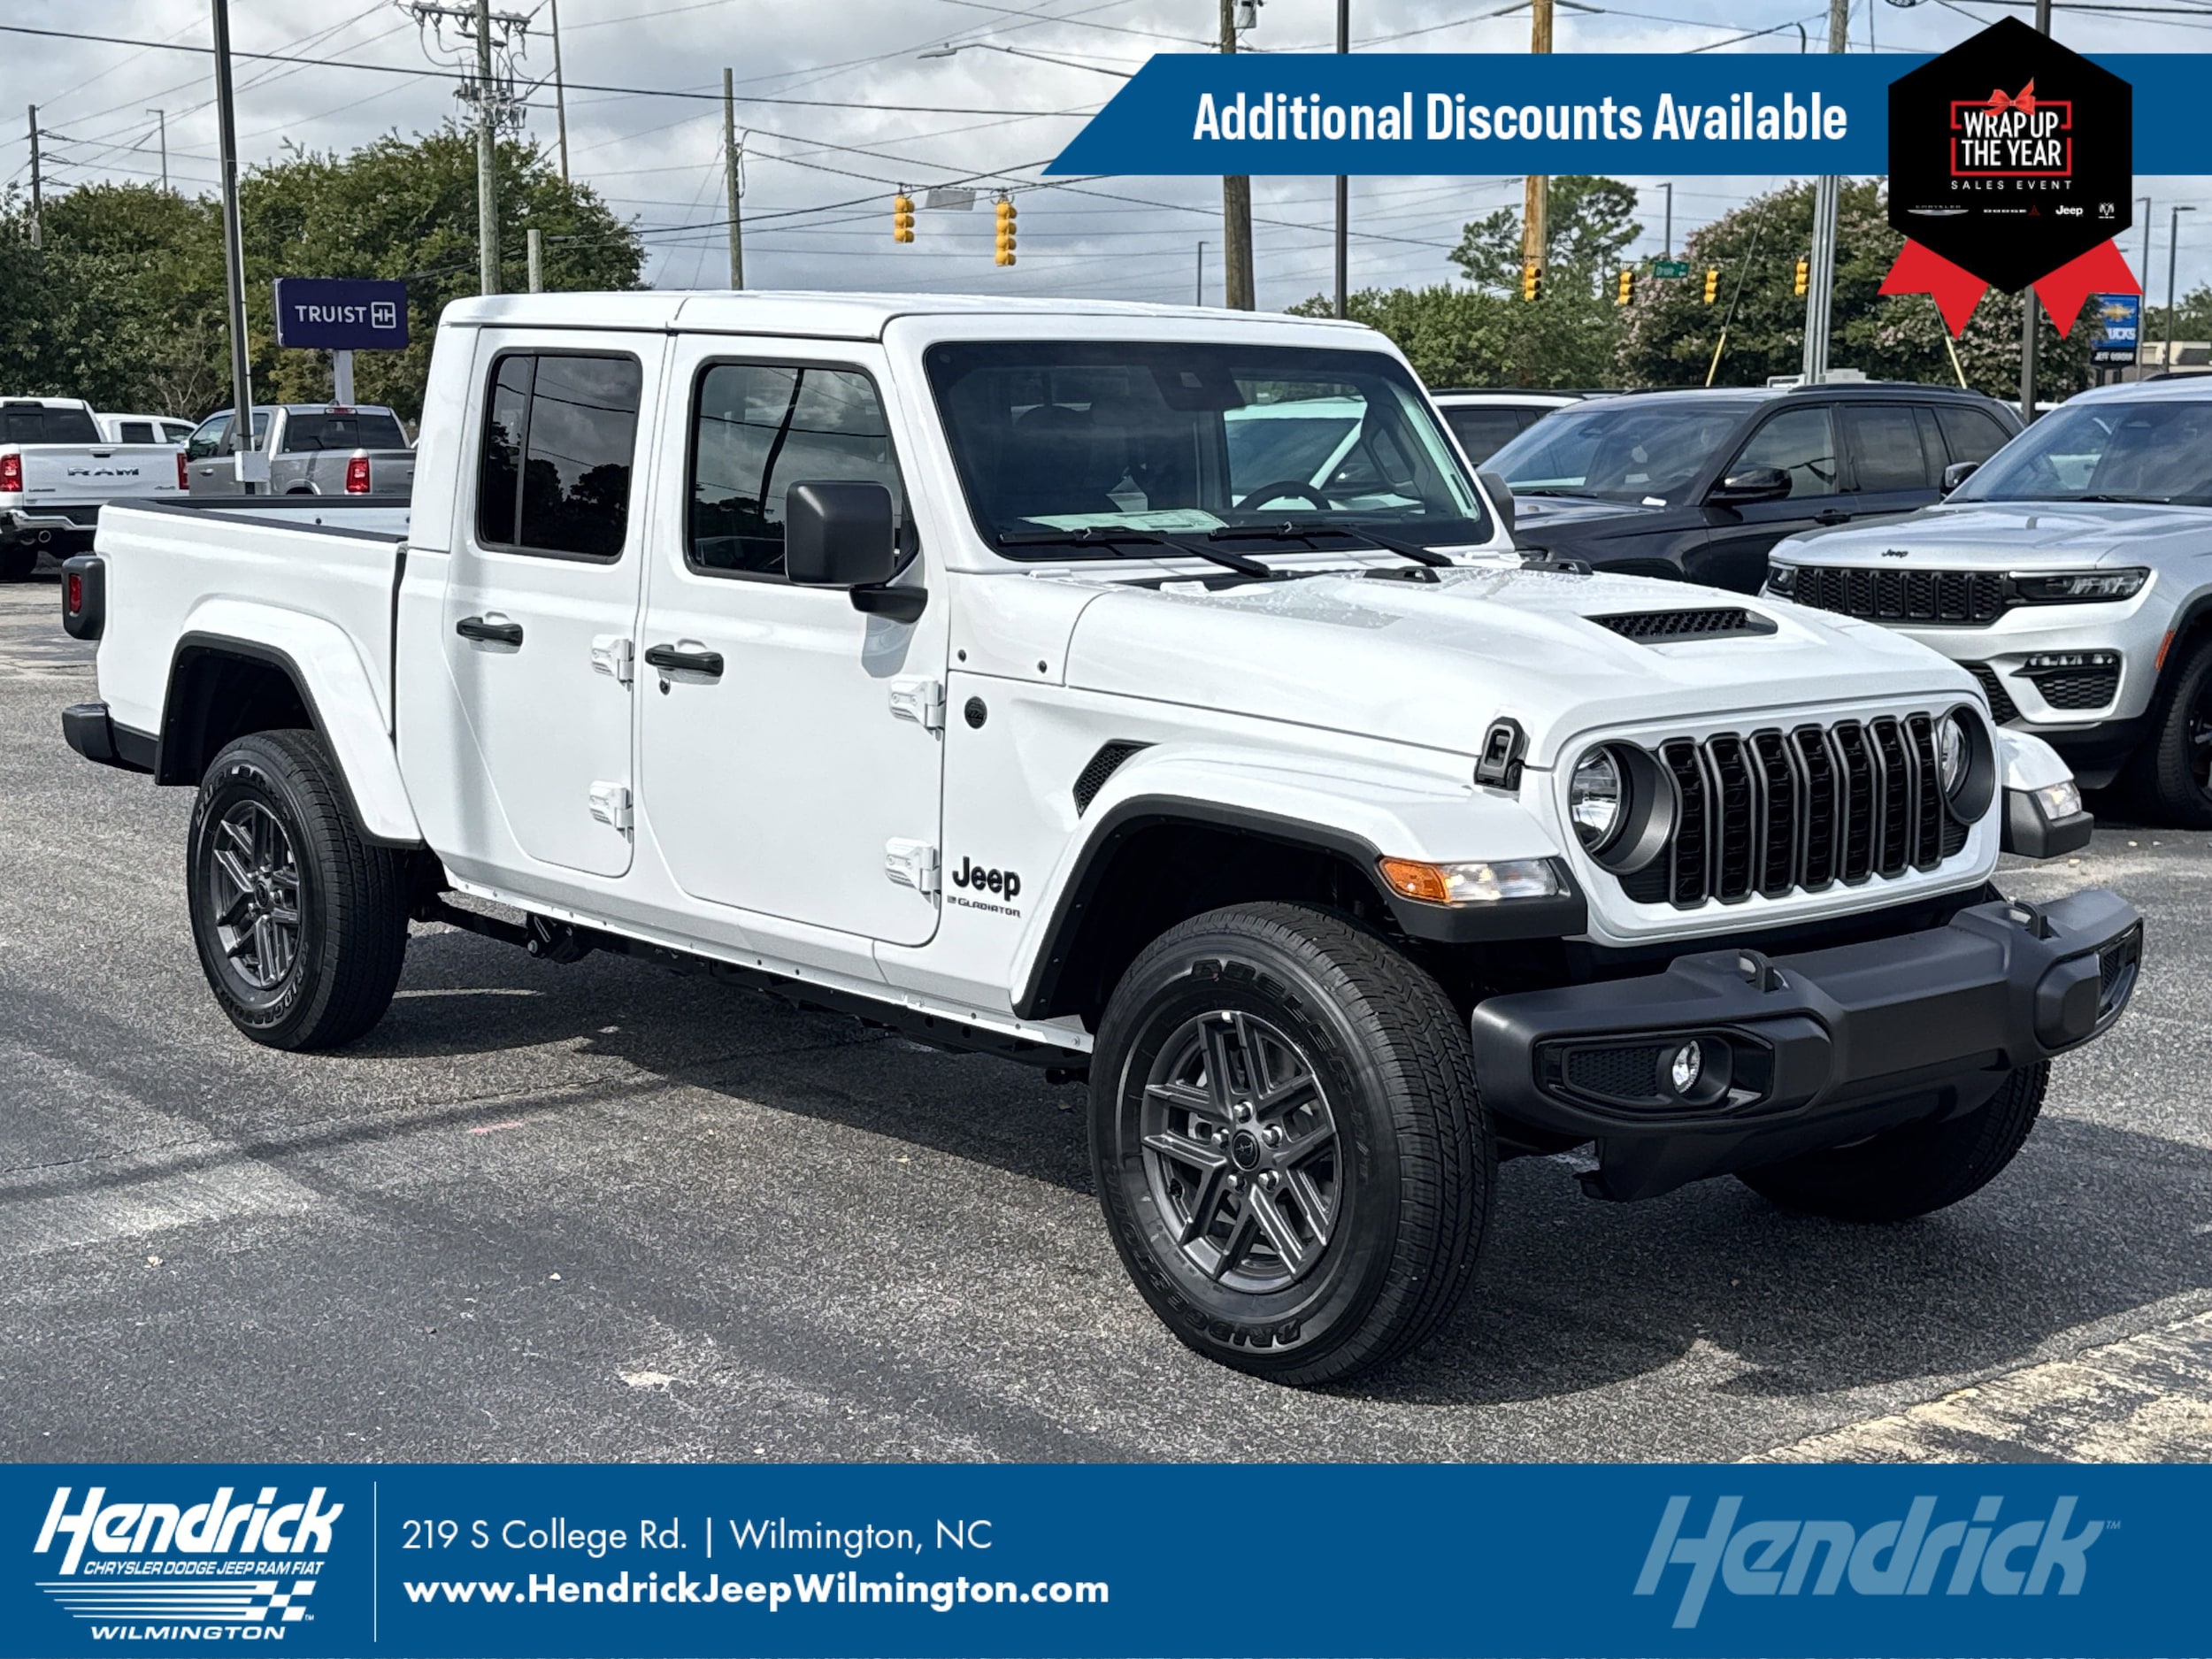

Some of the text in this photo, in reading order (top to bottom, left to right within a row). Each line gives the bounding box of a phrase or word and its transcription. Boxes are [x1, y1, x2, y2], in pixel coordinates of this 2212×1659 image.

[295, 305, 366, 323] TRUIST
[67, 466, 139, 476] RAM
[1881, 549, 1909, 558] Jeep
[952, 856, 1021, 902] Jeep
[957, 898, 1021, 918] GLADIATOR
